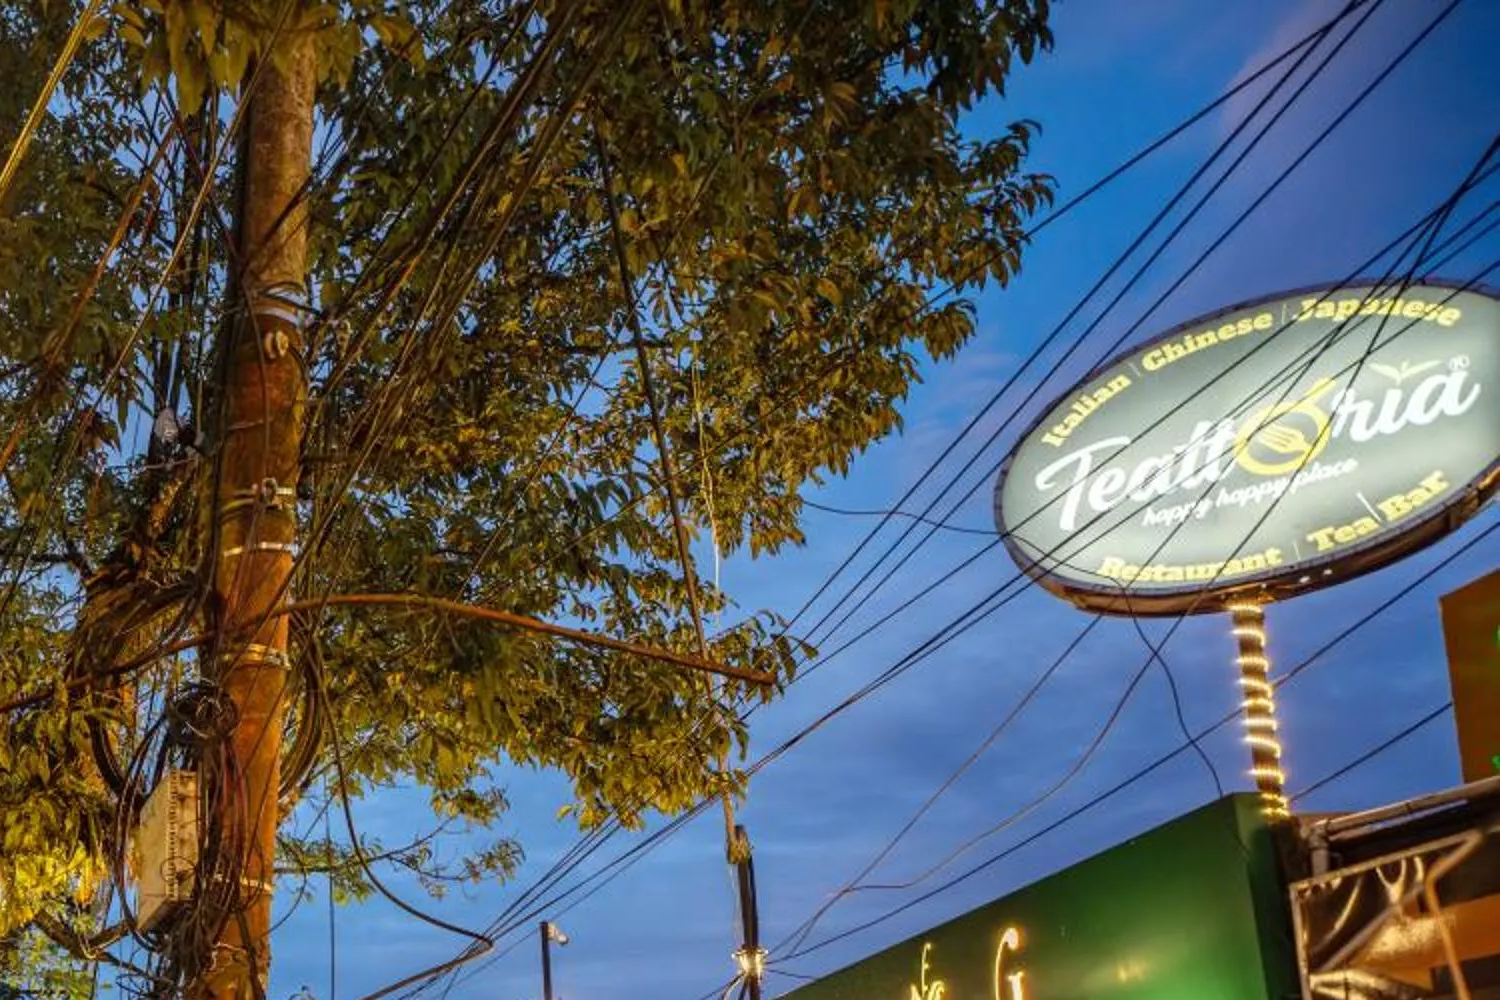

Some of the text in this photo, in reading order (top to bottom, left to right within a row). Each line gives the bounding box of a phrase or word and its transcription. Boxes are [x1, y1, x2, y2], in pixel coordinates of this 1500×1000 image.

[1041, 297, 1463, 448] Italian Chinese Japanese
[1097, 469, 1451, 584] Restaurant Tea Bar
[1142, 457, 1359, 526] happy happy place
